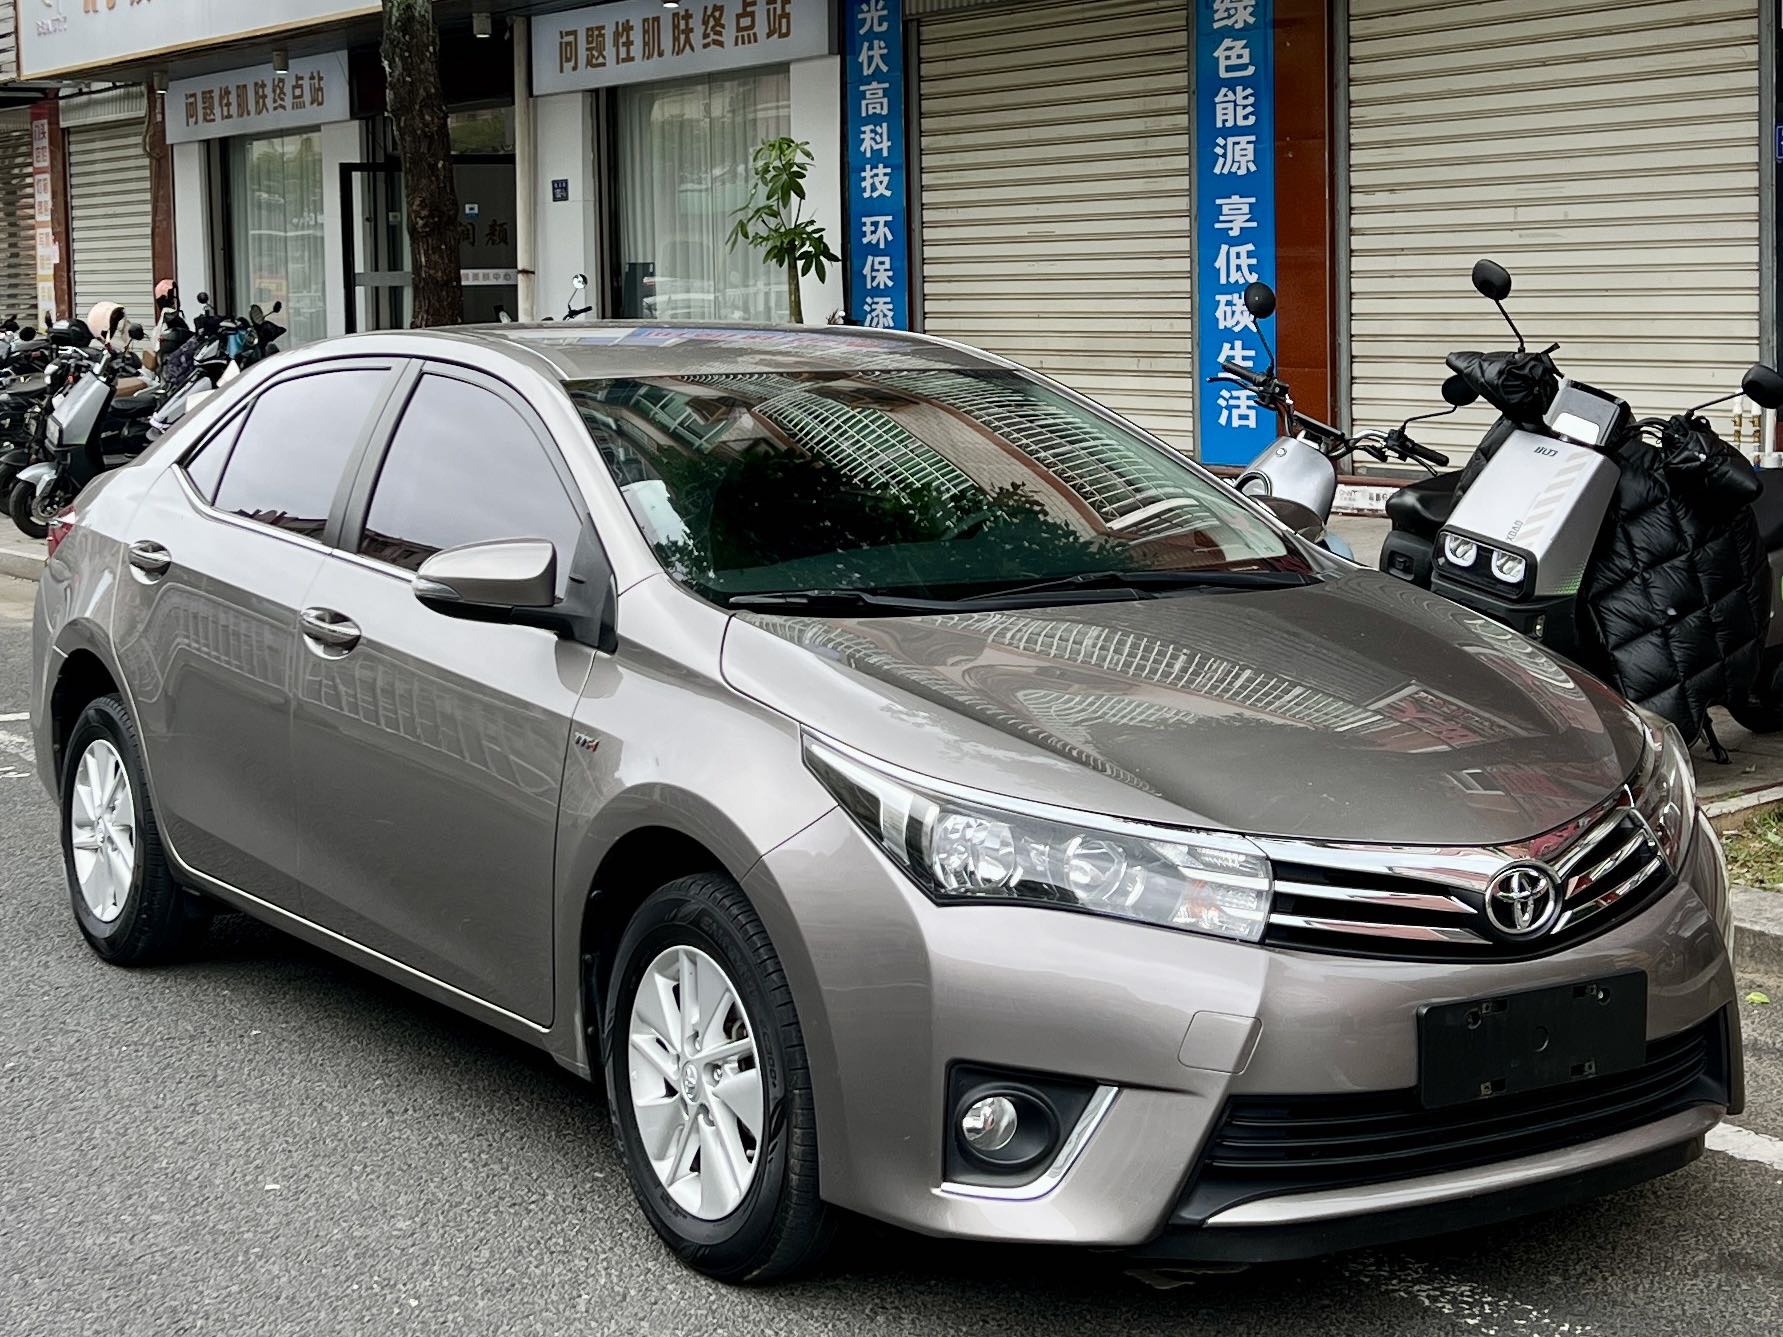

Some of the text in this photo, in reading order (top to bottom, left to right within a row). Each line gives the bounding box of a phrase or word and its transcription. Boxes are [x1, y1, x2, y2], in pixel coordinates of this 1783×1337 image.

[184, 69, 325, 127] 问题性肌肤终点站
[559, 0, 792, 74] 问题性肌肤终点站
[857, 0, 895, 329] 光伏高科技 环保添
[1212, 0, 1259, 429] 绿色能源 享低碳生活
